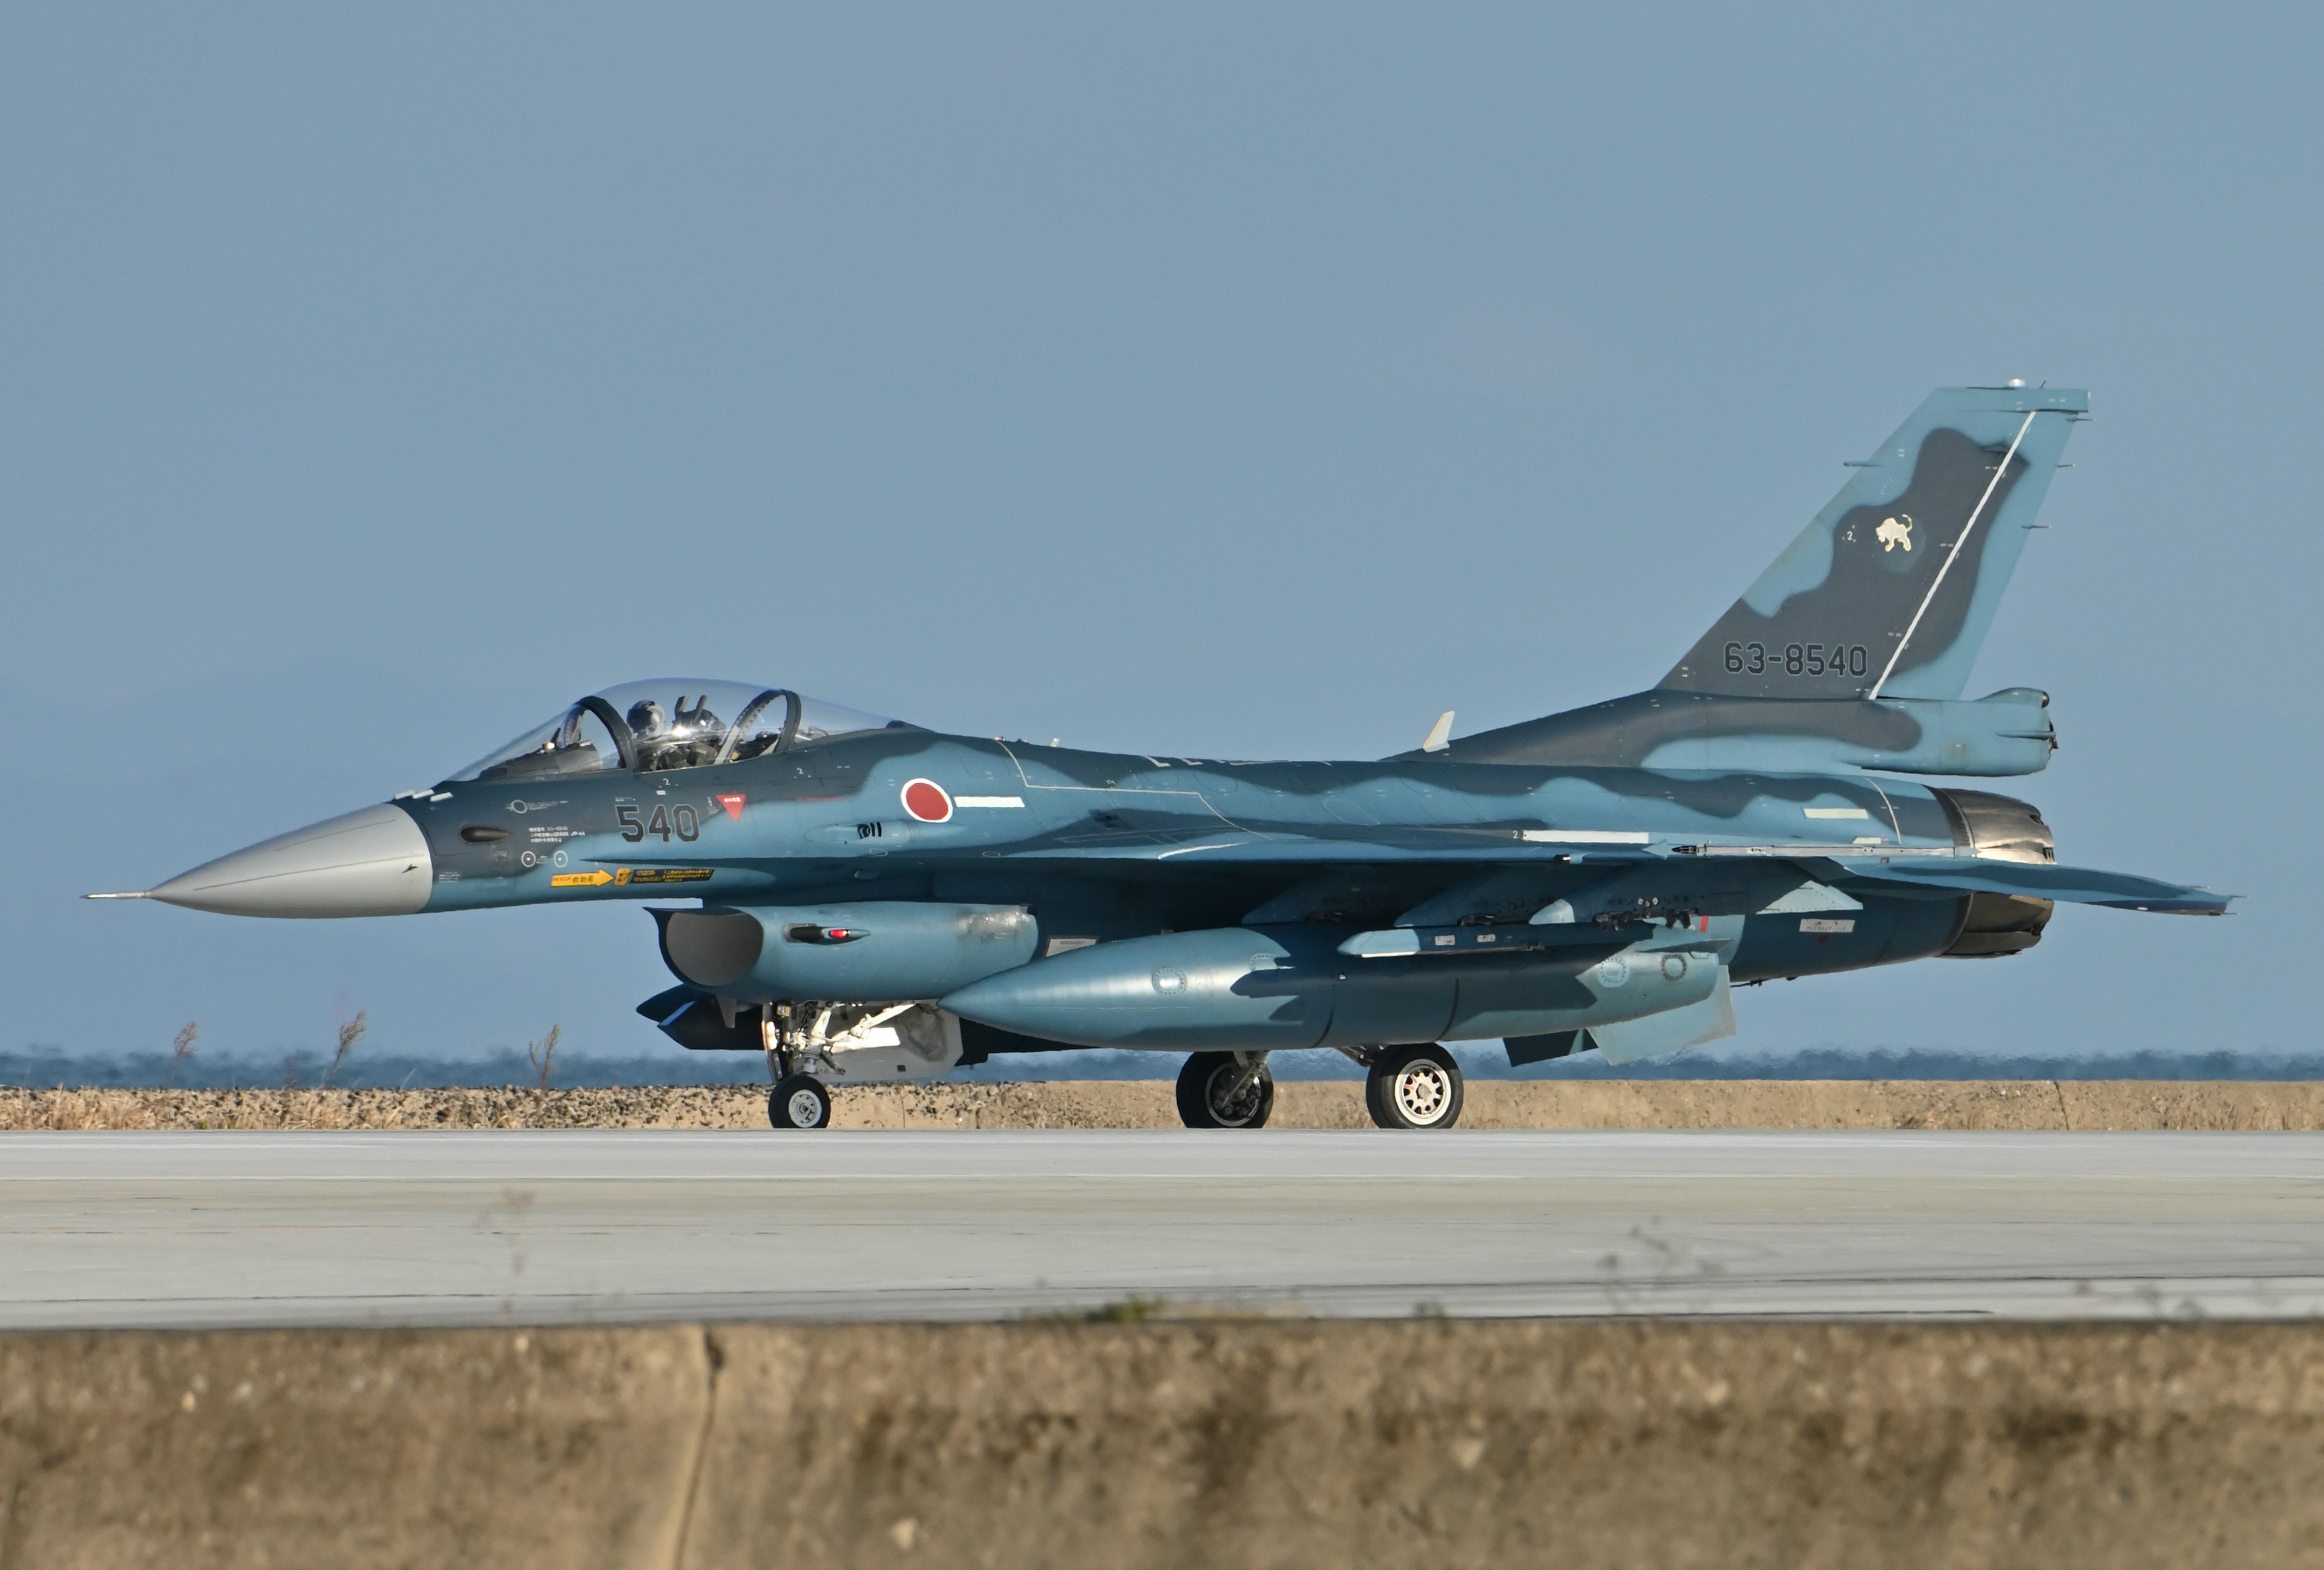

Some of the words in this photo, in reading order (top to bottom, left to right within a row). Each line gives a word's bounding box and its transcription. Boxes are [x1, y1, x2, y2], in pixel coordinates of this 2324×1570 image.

[1847, 531, 1853, 540] 2
[1724, 642, 1867, 677] 63-8540
[615, 804, 700, 842] 540
[1512, 830, 1518, 839] 2
